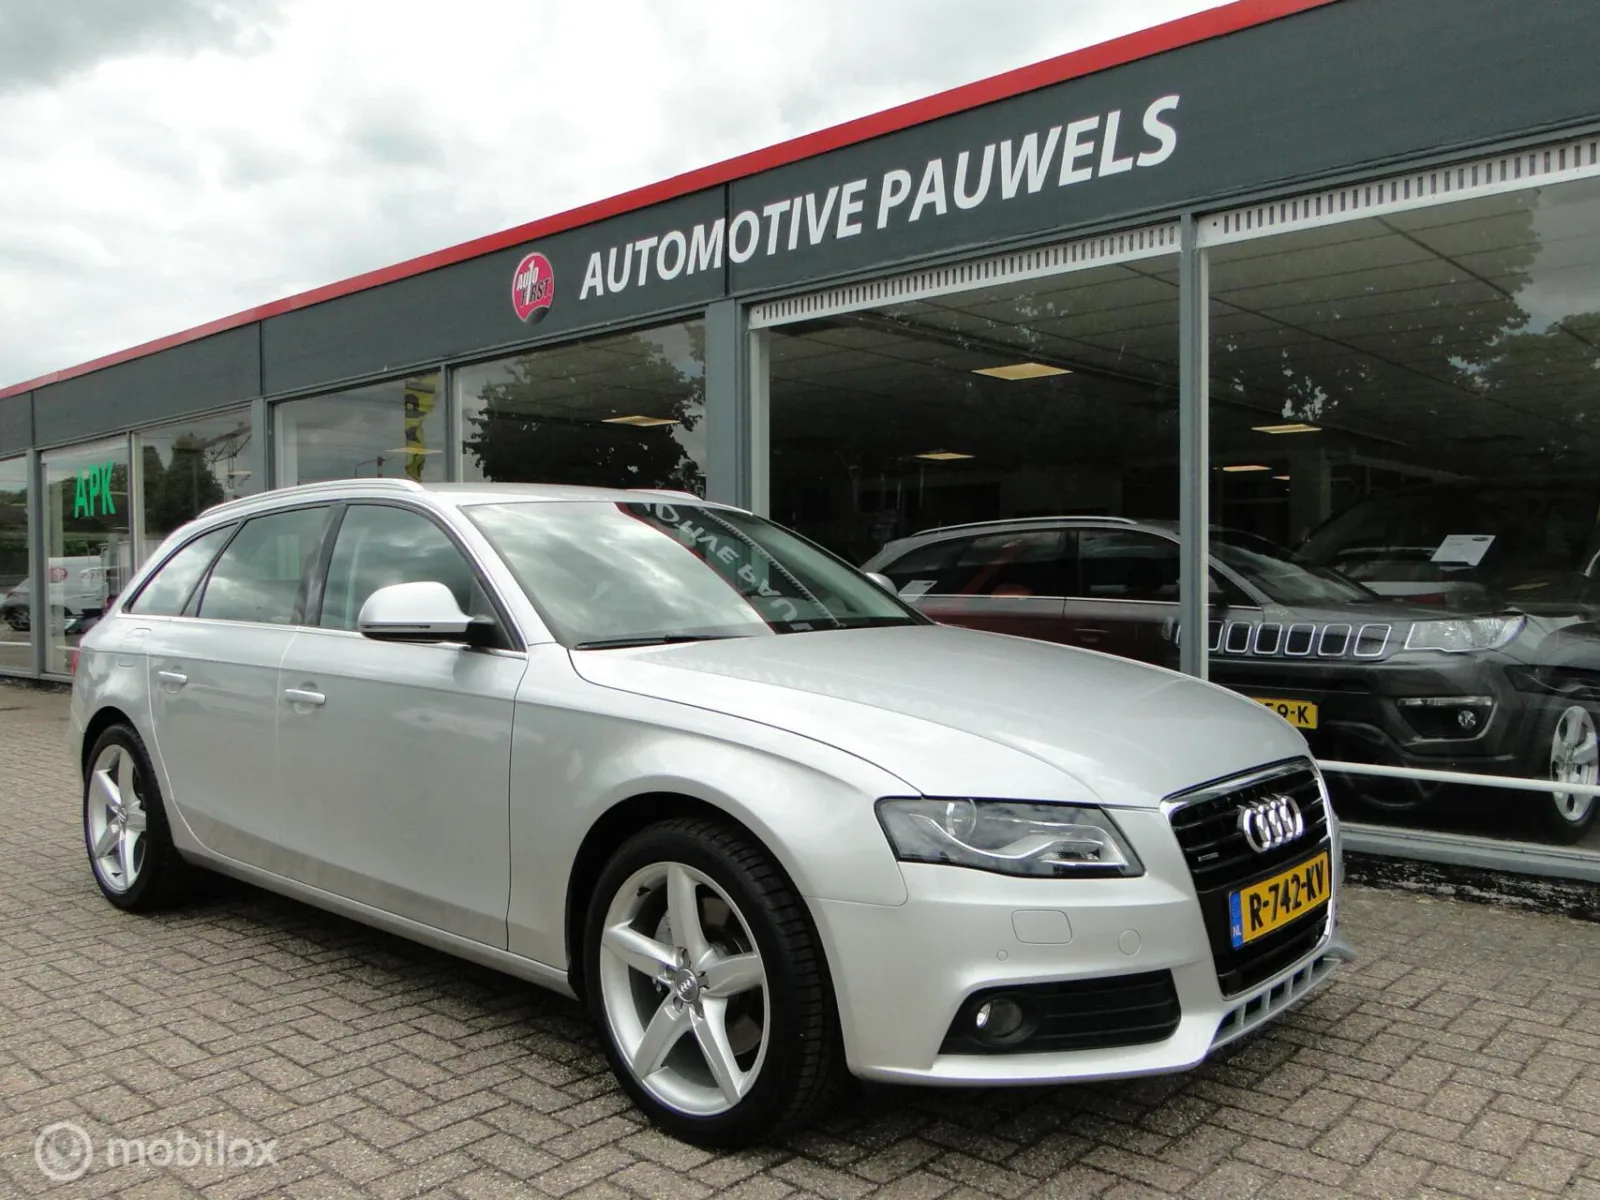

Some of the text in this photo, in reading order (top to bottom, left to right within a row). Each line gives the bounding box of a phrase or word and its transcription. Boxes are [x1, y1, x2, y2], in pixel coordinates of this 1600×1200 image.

[579, 94, 1181, 301] AUTOMOTIVE PAUWELS
[74, 458, 117, 518] APK
[1249, 859, 1325, 932] R-742-KV
